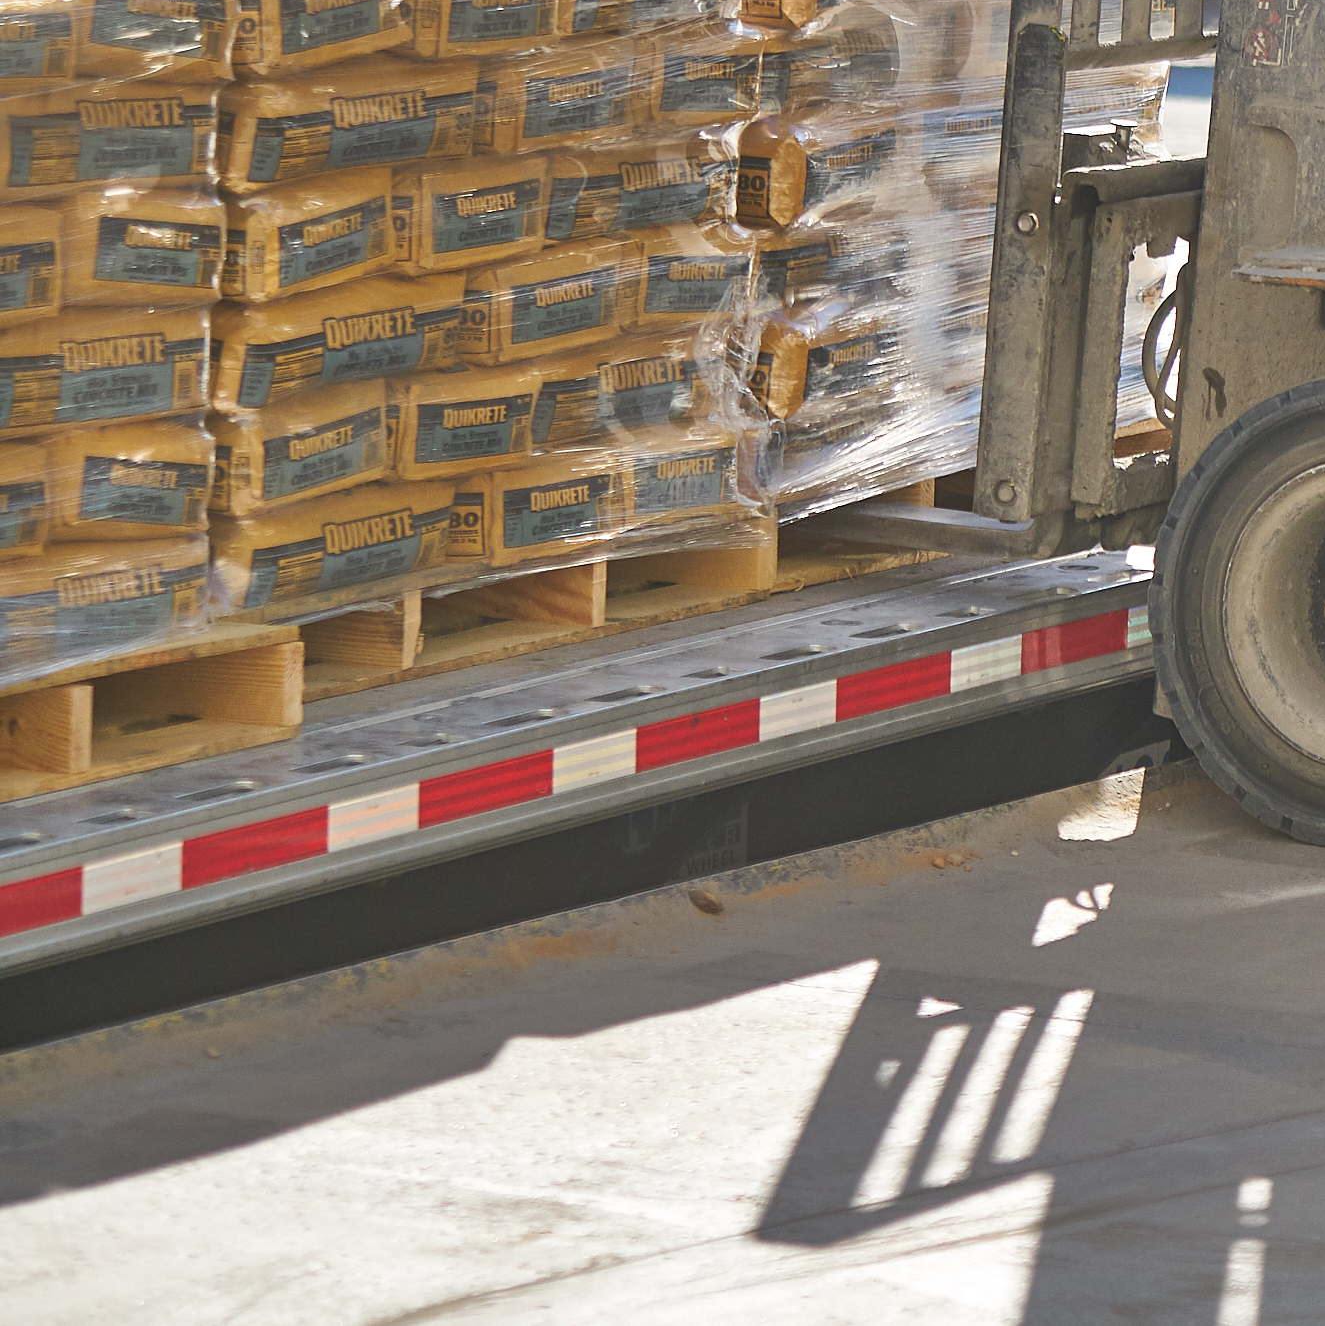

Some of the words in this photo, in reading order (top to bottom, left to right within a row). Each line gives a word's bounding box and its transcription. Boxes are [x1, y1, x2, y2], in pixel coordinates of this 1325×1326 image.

[79, 98, 185, 129] QUIKRETE
[332, 90, 427, 129] QUIKRETE
[457, 191, 518, 217] QUIKRETE
[535, 280, 595, 307] QUIKRETE
[323, 307, 416, 350] QUIKRETE
[62, 334, 166, 373] QUIKRETE
[601, 359, 684, 393] QUIKRETE
[443, 405, 507, 429] QUIKRETE
[289, 425, 353, 461] QUIKRETE
[530, 485, 591, 513] QUIKRETE
[322, 509, 415, 555] QUIKRETE
